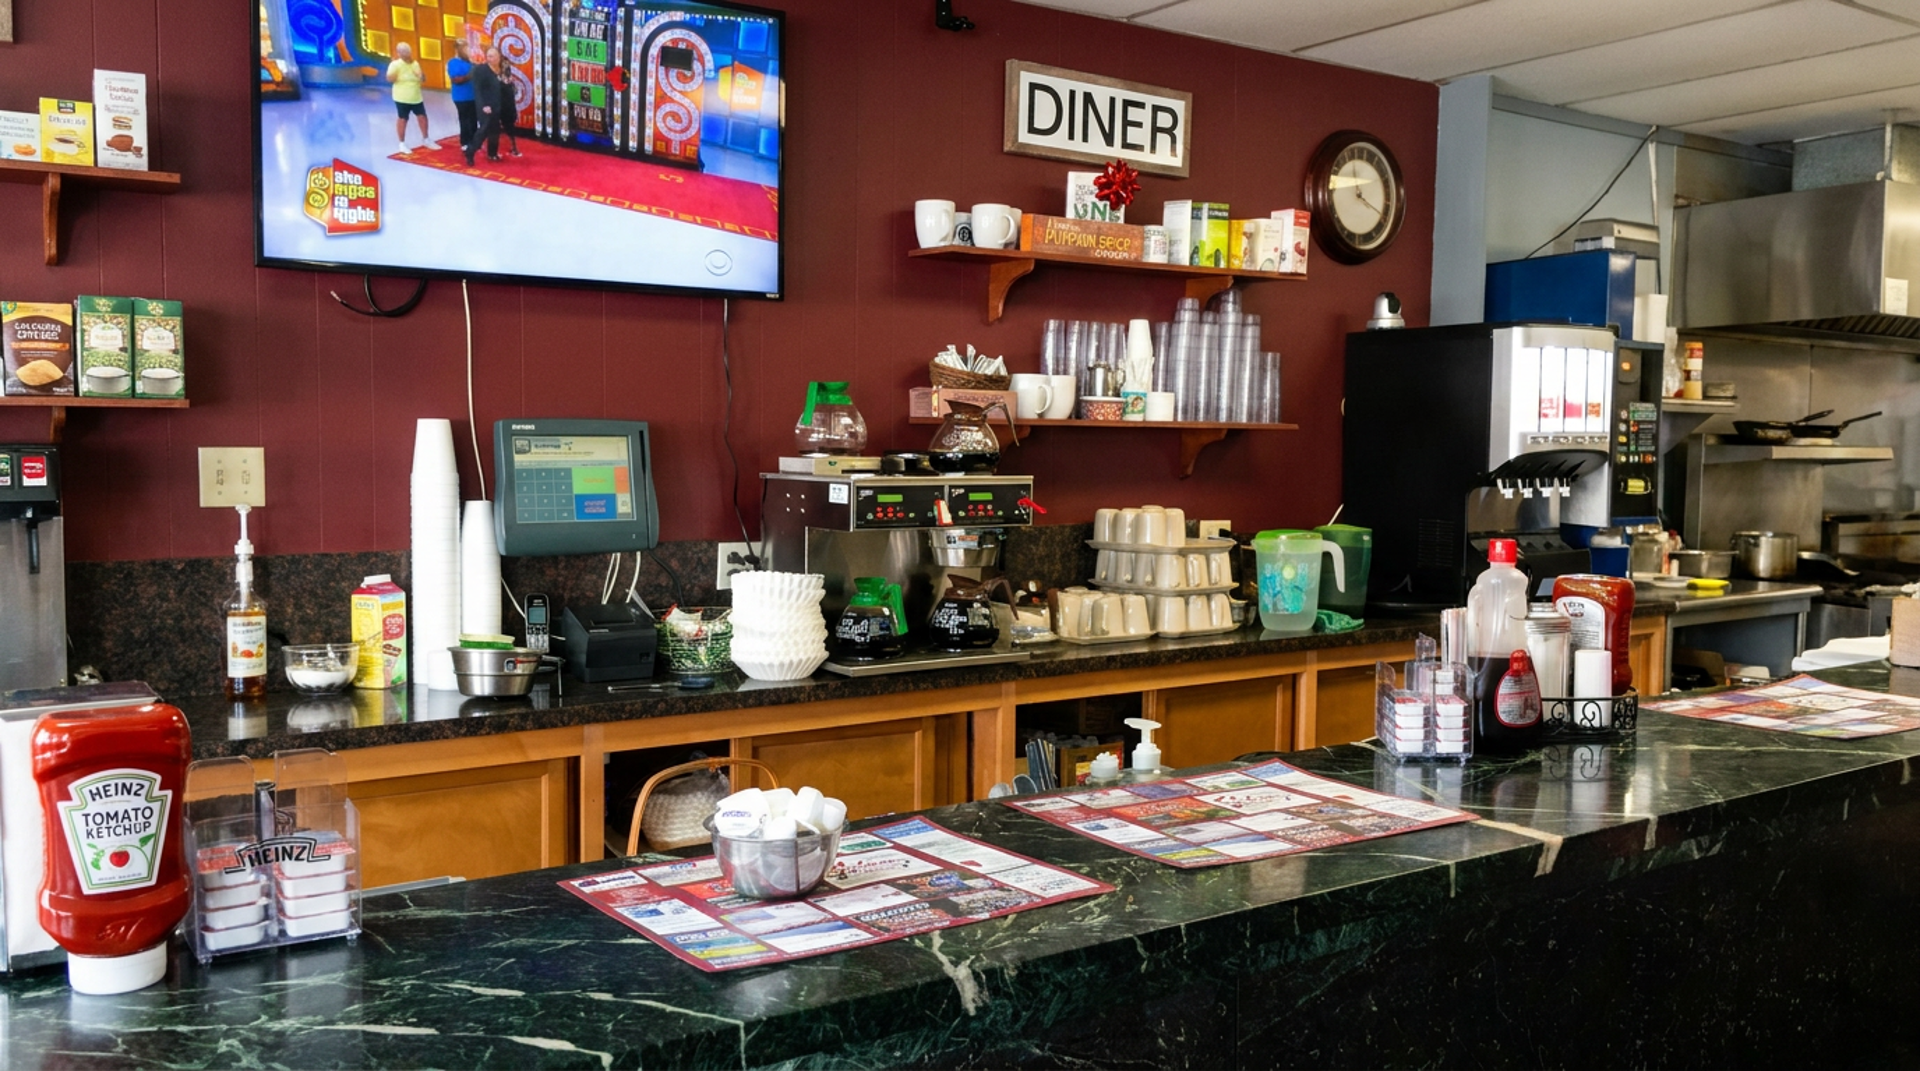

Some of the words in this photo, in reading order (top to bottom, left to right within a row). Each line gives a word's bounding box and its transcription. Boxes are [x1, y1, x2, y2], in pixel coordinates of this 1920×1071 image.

[1027, 81, 1179, 158] DINER
[89, 782, 145, 802] HEINZ
[81, 805, 154, 827] TOMATO
[86, 821, 152, 840] KETCHUP
[248, 844, 308, 868] HEINZ
